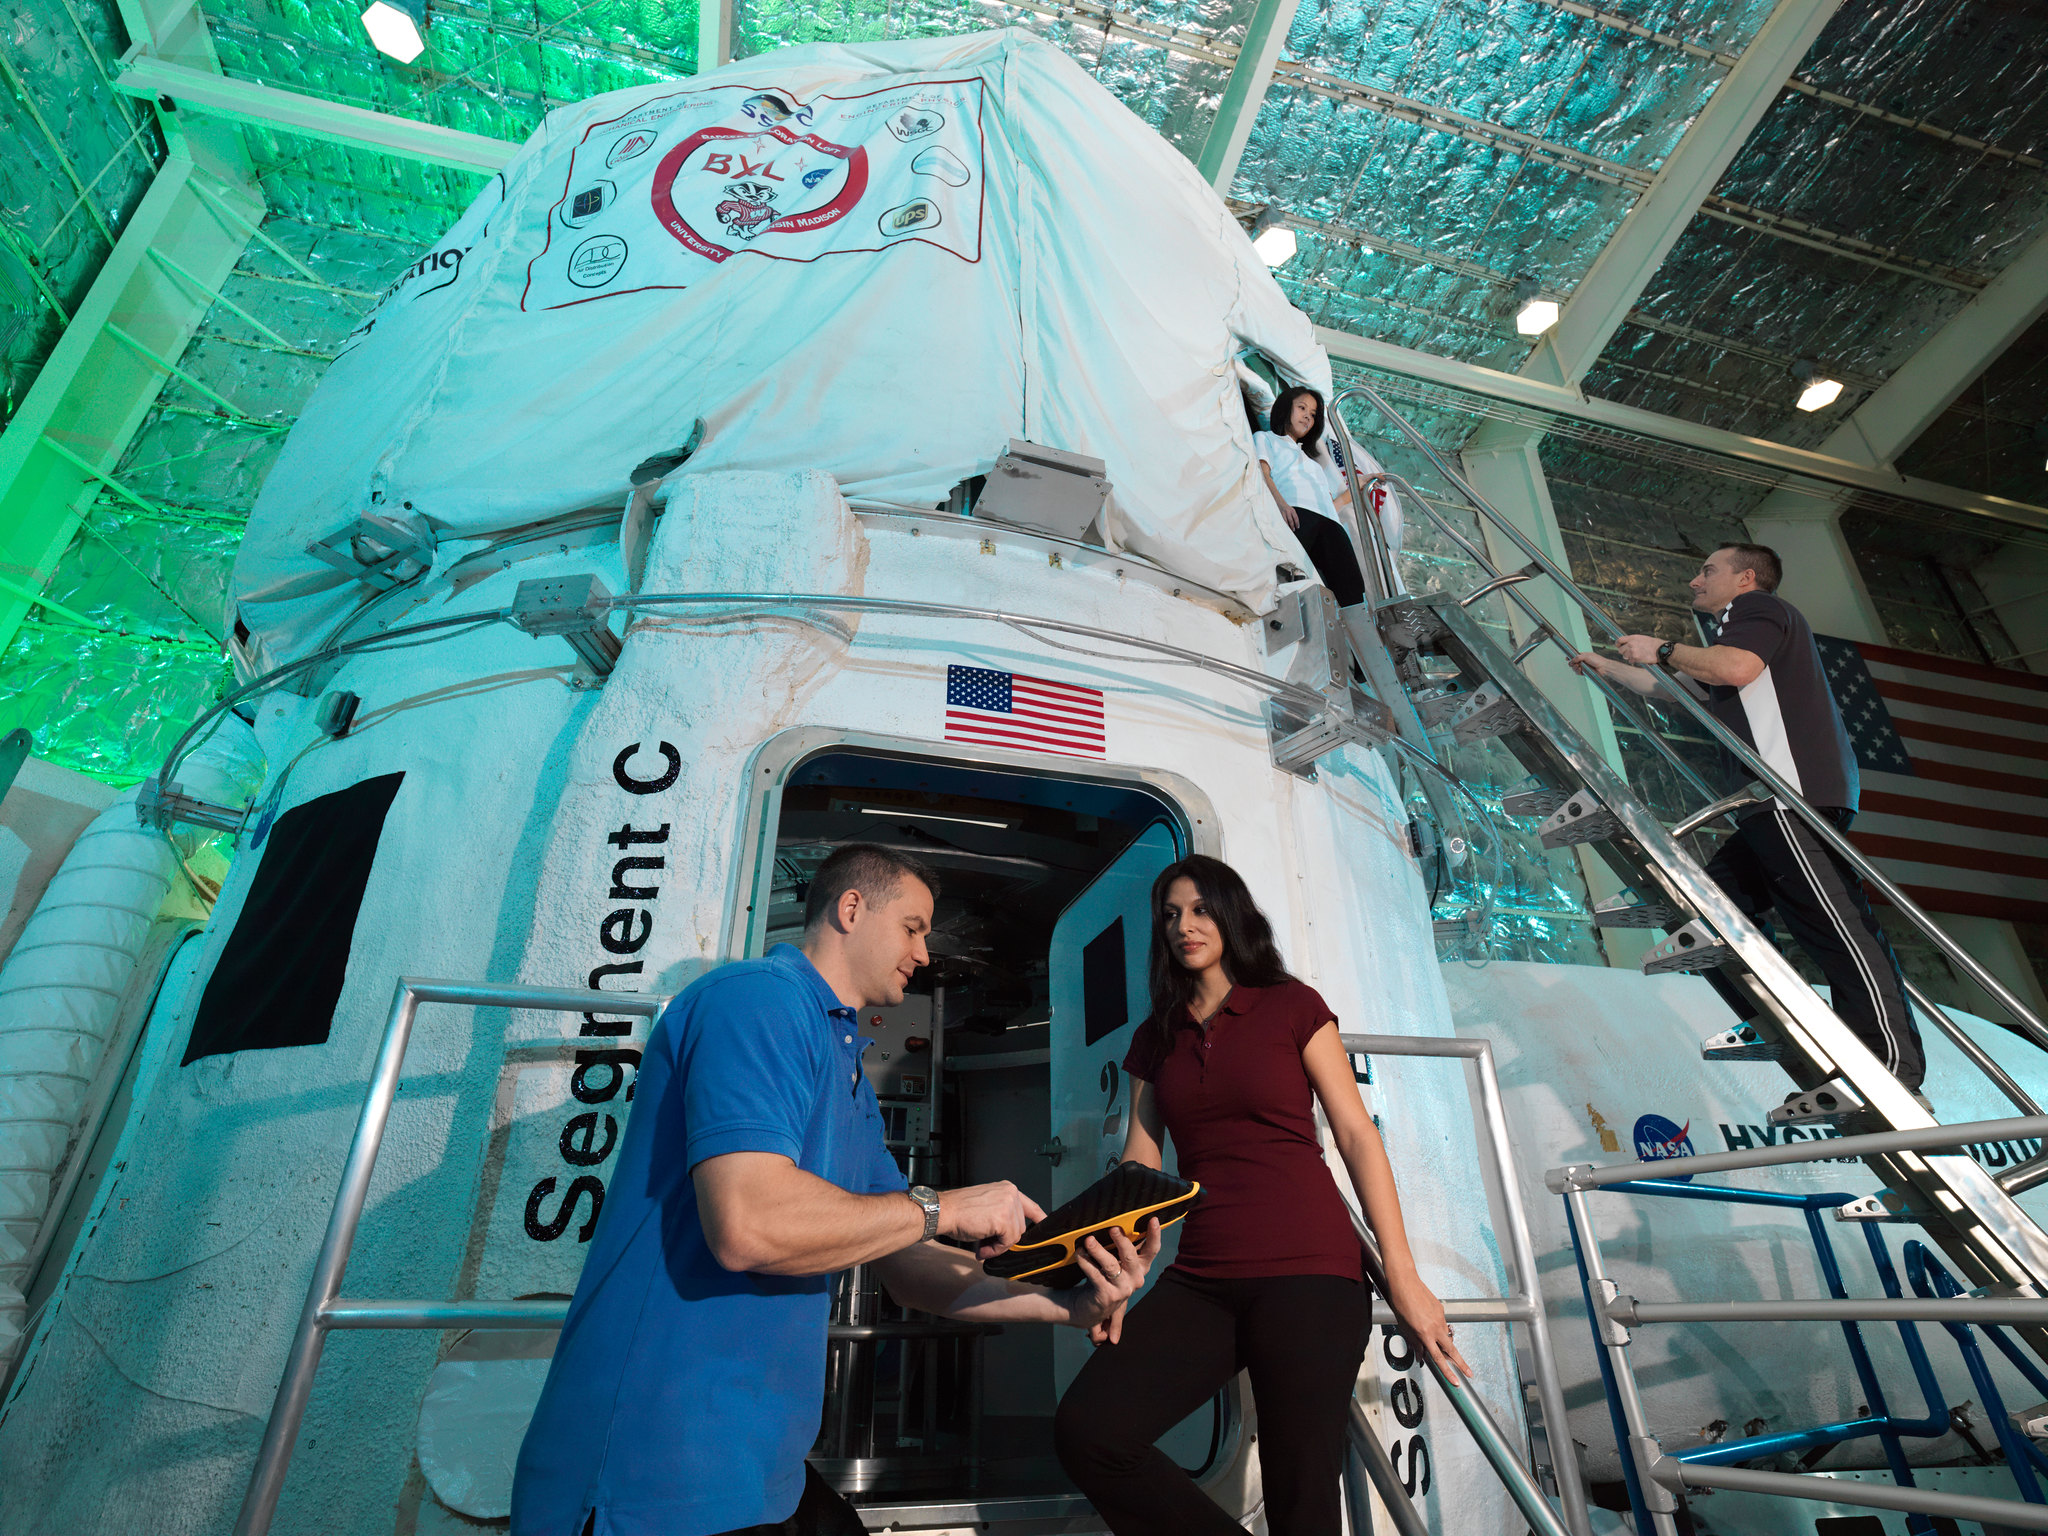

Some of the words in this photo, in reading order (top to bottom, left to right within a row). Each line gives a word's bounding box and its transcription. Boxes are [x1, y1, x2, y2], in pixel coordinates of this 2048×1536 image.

[701, 153, 785, 182] BXL
[796, 208, 841, 228] MADISON
[894, 208, 926, 227] ups
[670, 220, 725, 258] UNIVERSITY
[612, 740, 682, 796] C
[1100, 1060, 1122, 1138] 2
[1638, 1141, 1693, 1158] NASA
